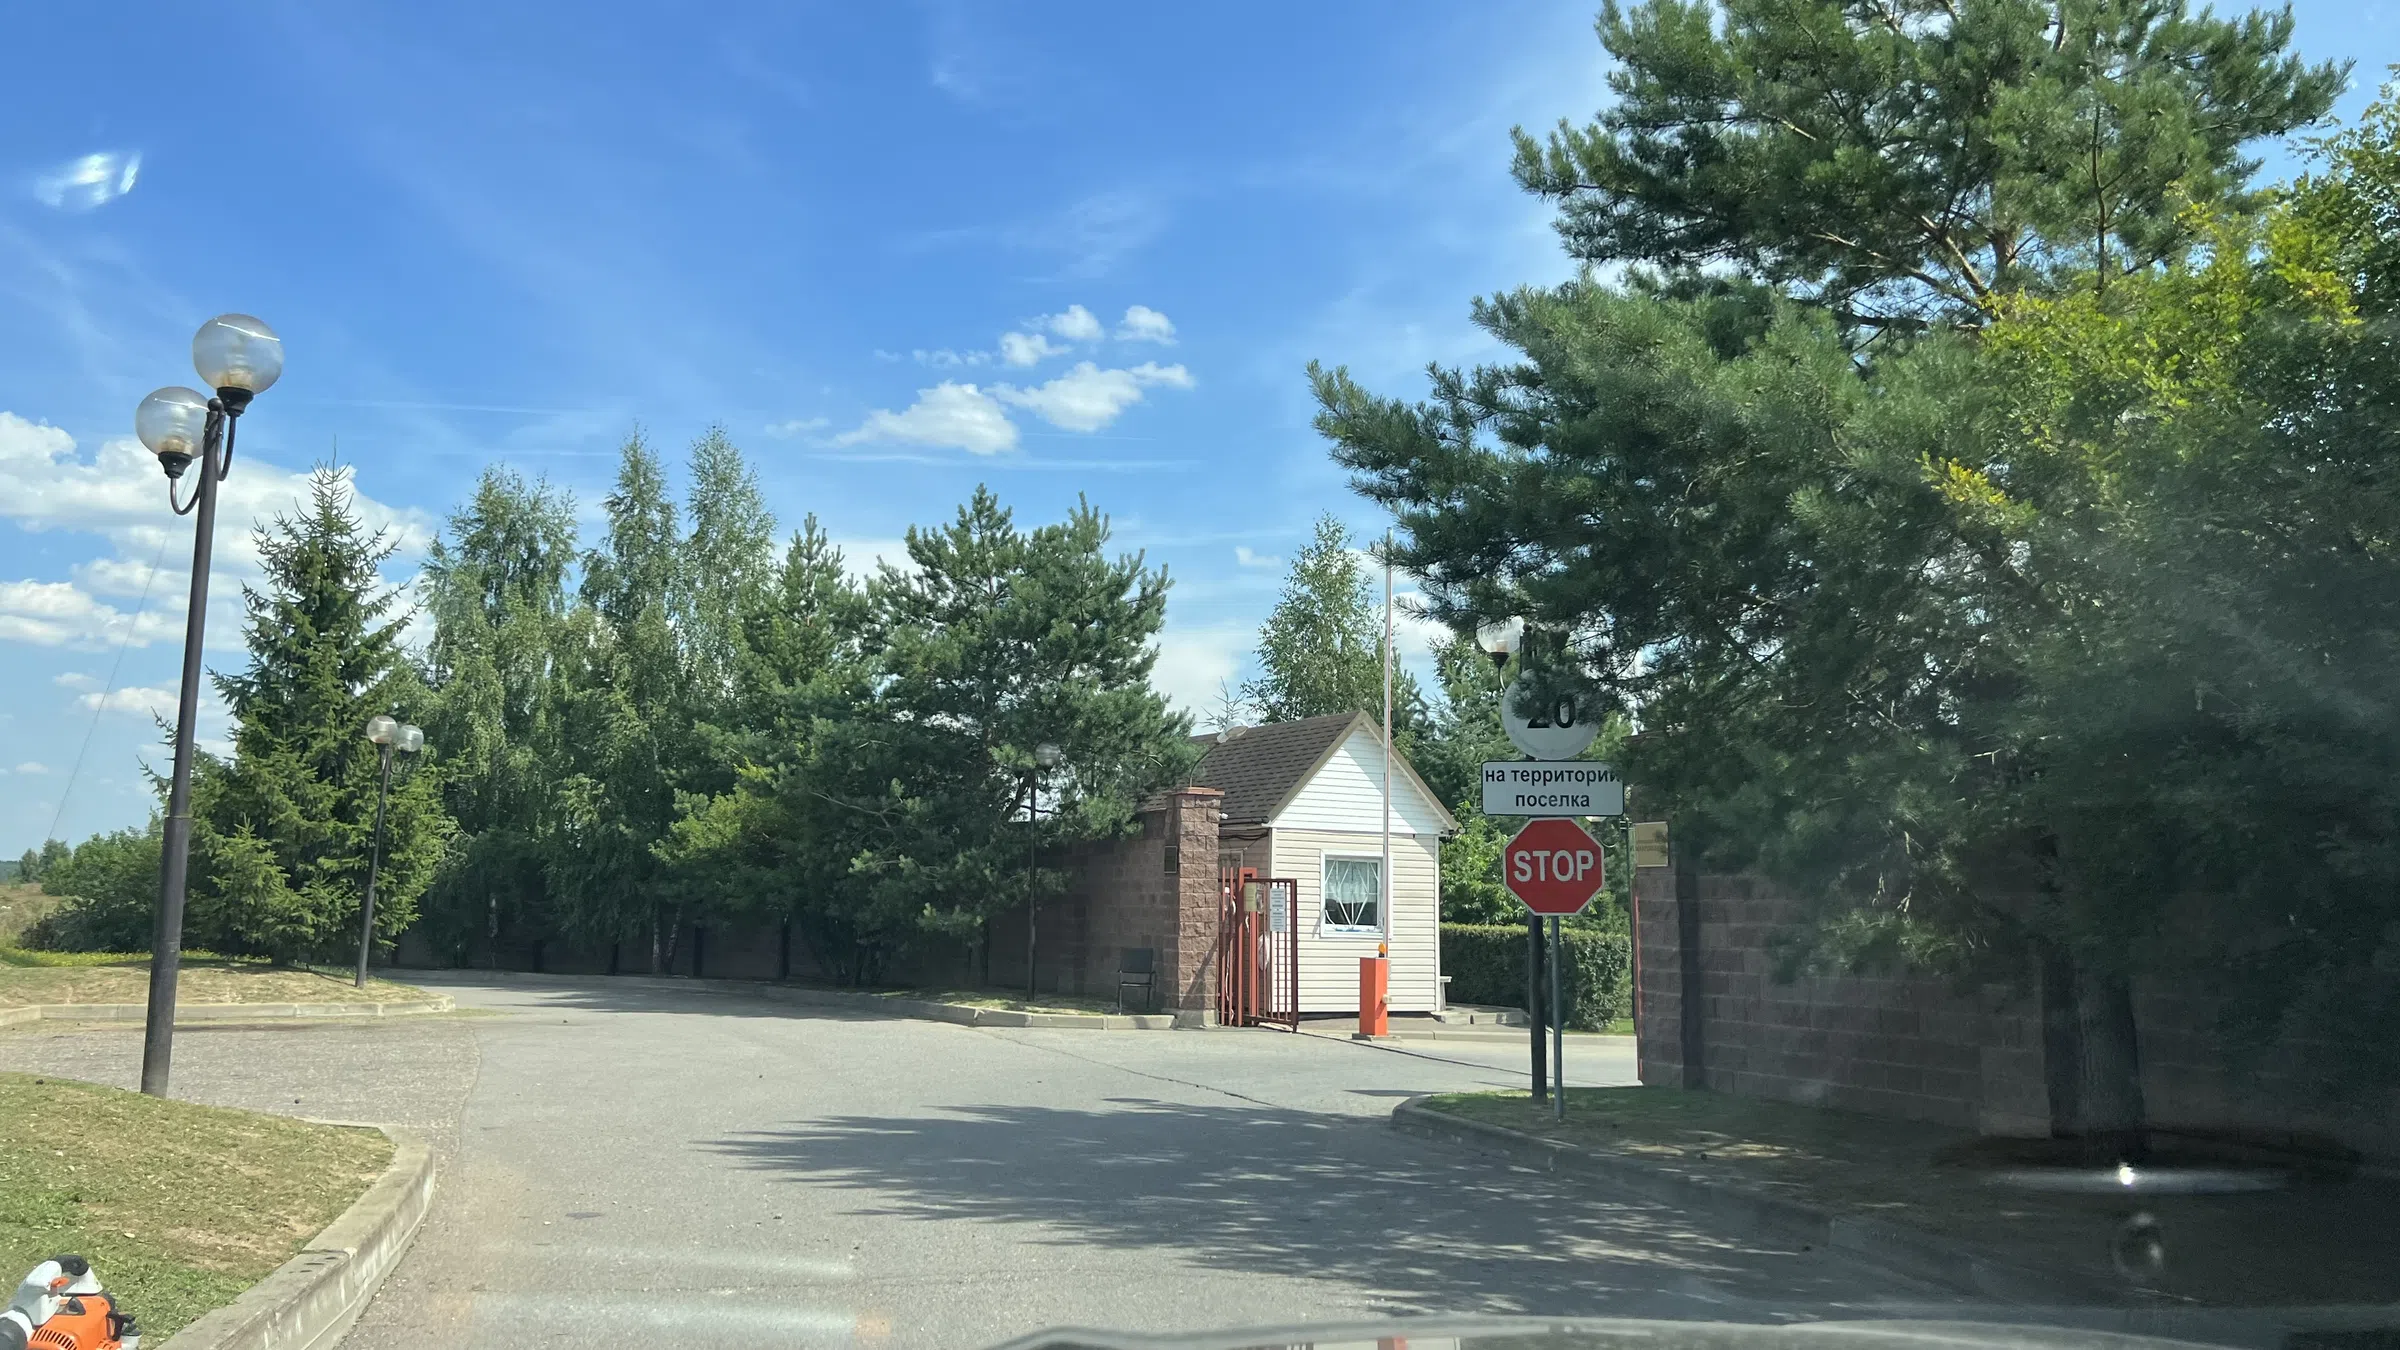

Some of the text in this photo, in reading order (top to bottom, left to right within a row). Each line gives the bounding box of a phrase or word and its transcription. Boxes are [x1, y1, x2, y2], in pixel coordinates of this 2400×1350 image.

[1485, 770, 1505, 782] на
[1515, 794, 1590, 807] поселка
[1513, 850, 1594, 882] STOP
